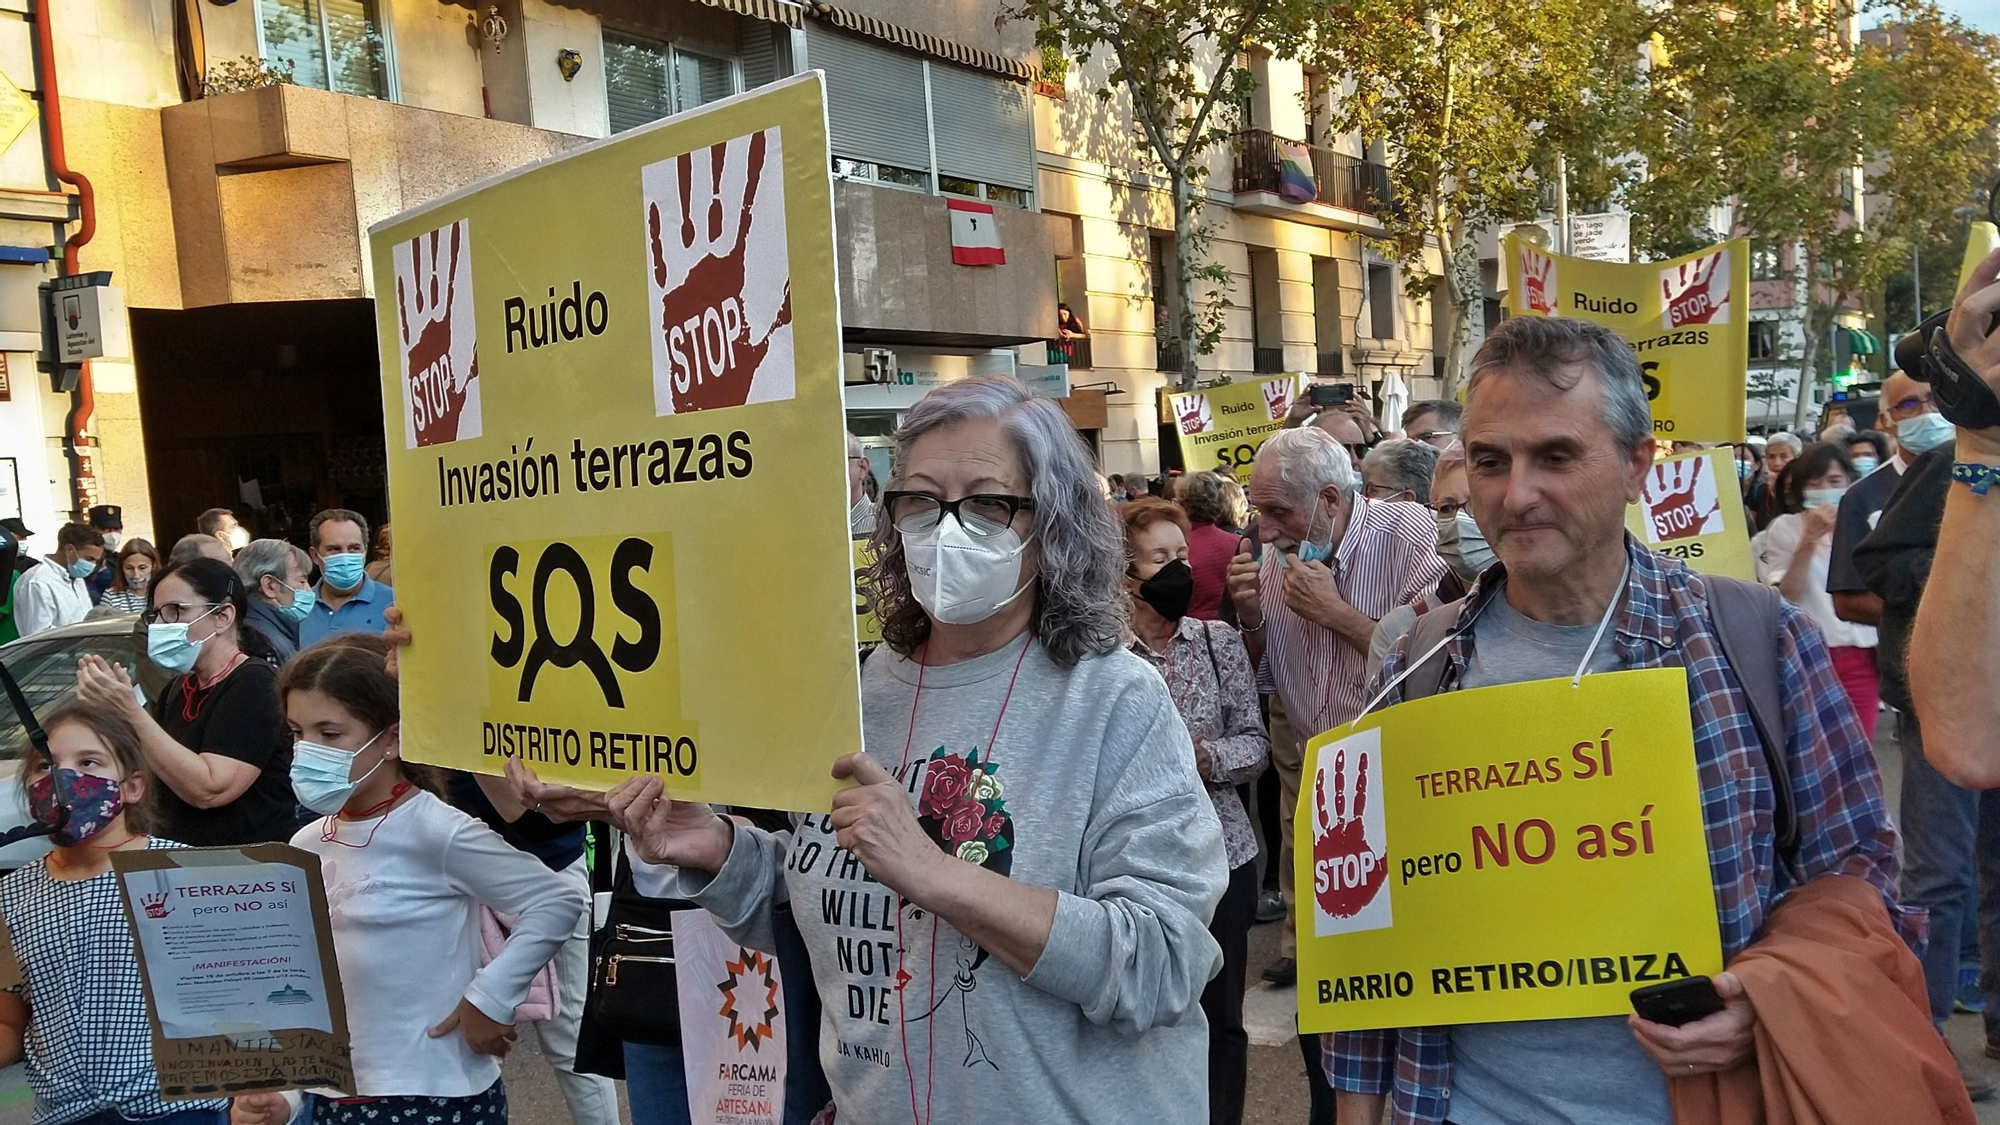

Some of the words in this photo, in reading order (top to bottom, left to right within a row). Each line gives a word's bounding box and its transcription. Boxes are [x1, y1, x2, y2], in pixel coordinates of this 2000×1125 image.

[504, 280, 610, 354] Ruido
[1573, 292, 1638, 315] Ruido
[1671, 292, 1708, 324] STOP
[669, 297, 743, 395] STOP
[1627, 330, 1710, 353] errazas
[411, 354, 451, 432] STOP
[1221, 402, 1255, 415] Ruido
[1182, 417, 1201, 433] STOP
[1194, 428, 1243, 445] Invasión
[438, 437, 560, 507] Invasión
[570, 430, 753, 492] terrazas
[1654, 503, 1695, 536] STOP
[489, 537, 662, 709] SOS
[483, 721, 581, 767] DISTRITO
[589, 731, 698, 777] RETIRO
[1415, 756, 1562, 799] TERRAZAS
[1572, 728, 1613, 780] SÍ
[1401, 851, 1462, 886] pero
[1471, 817, 1557, 870] NO
[1576, 804, 1656, 861] así
[175, 881, 276, 898] TERRAZAS
[281, 880, 297, 894] SÍ
[1314, 850, 1377, 894] STOP
[192, 903, 230, 918] pero
[234, 900, 263, 912] NO
[268, 899, 289, 910] así
[822, 888, 895, 932] WILL
[192, 956, 292, 972] ¡MANIFESTACIÓN!
[837, 936, 893, 977] NOT
[1317, 971, 1414, 1005] BARRIO
[1432, 952, 1691, 996] RETIRO/IBIZA
[848, 984, 892, 1026] DIE
[719, 1063, 777, 1083] FARCAMA
[854, 1044, 891, 1069] KAHLO
[728, 1083, 751, 1097] FERIA
[752, 1084, 766, 1098] DE
